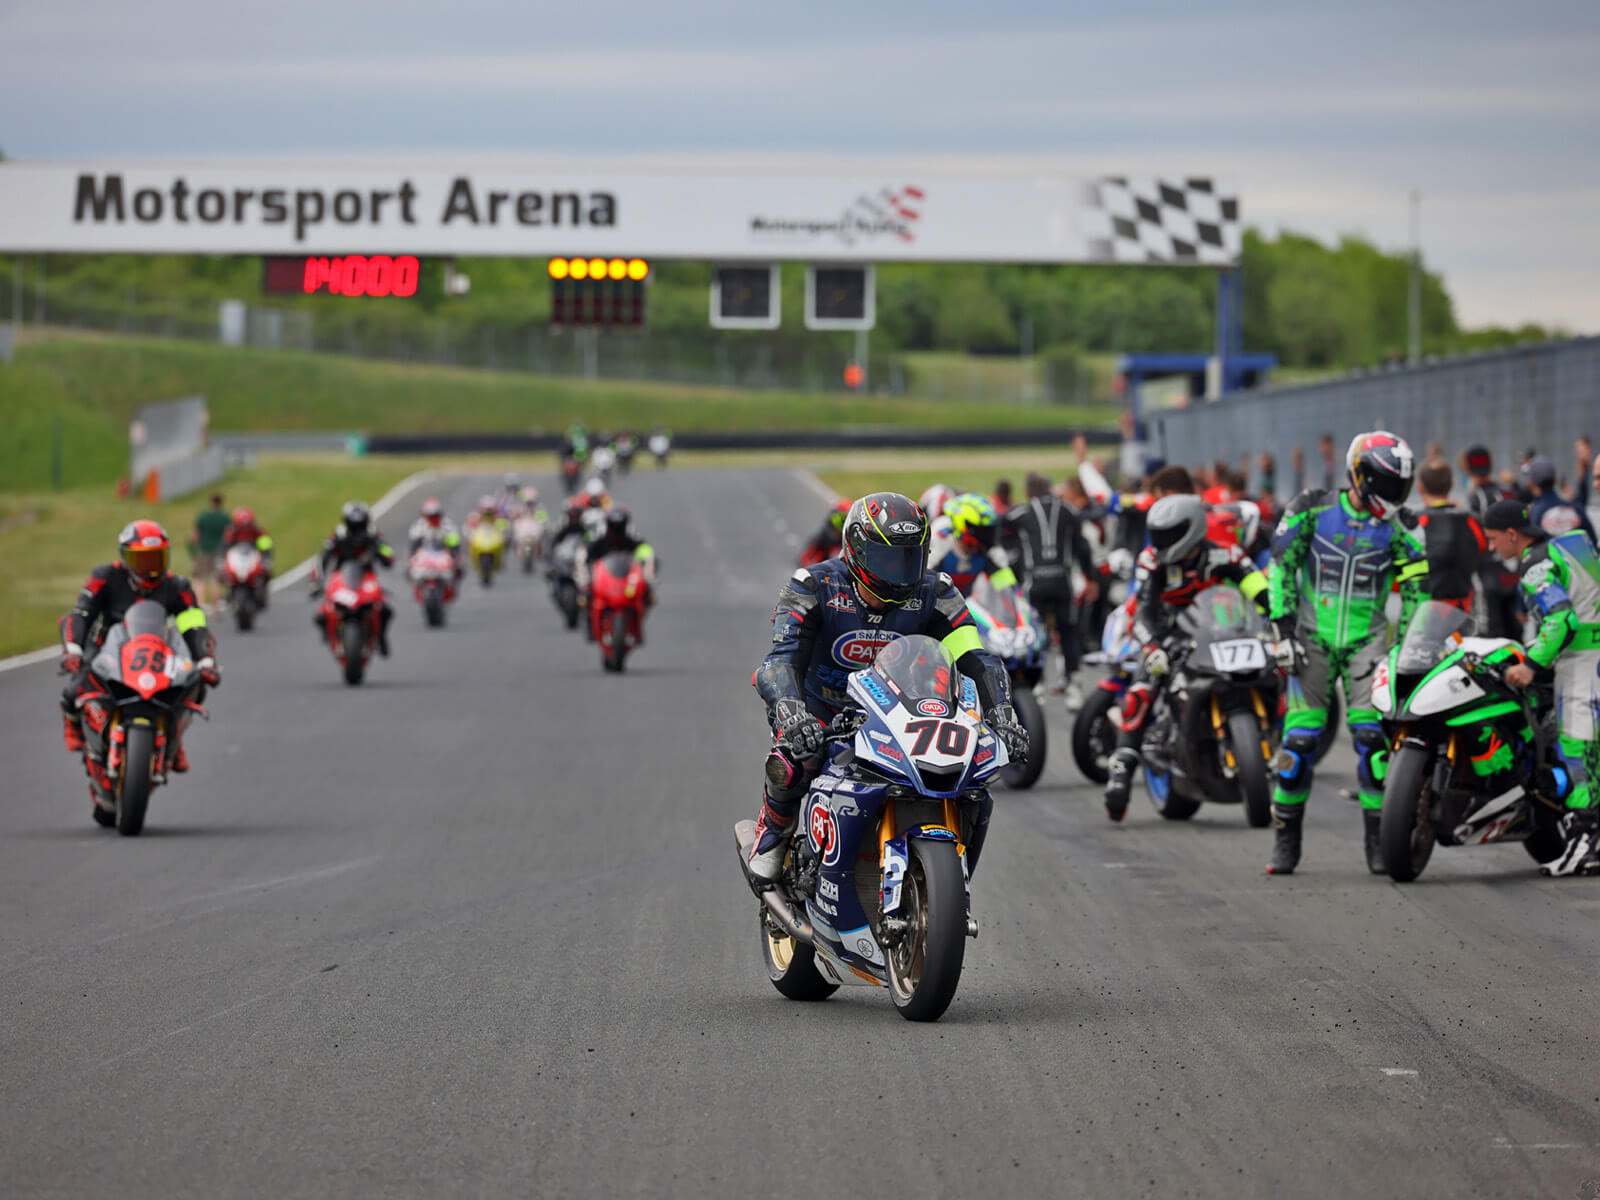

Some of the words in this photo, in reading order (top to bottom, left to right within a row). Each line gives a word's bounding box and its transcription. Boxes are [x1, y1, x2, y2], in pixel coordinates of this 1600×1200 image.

[73, 173, 417, 242] Motorsport
[441, 176, 618, 227] Arena
[867, 614, 883, 624] 70
[858, 632, 894, 641] SNACK
[848, 643, 894, 659] PATA
[923, 704, 943, 712] PATA
[904, 719, 970, 757] 70
